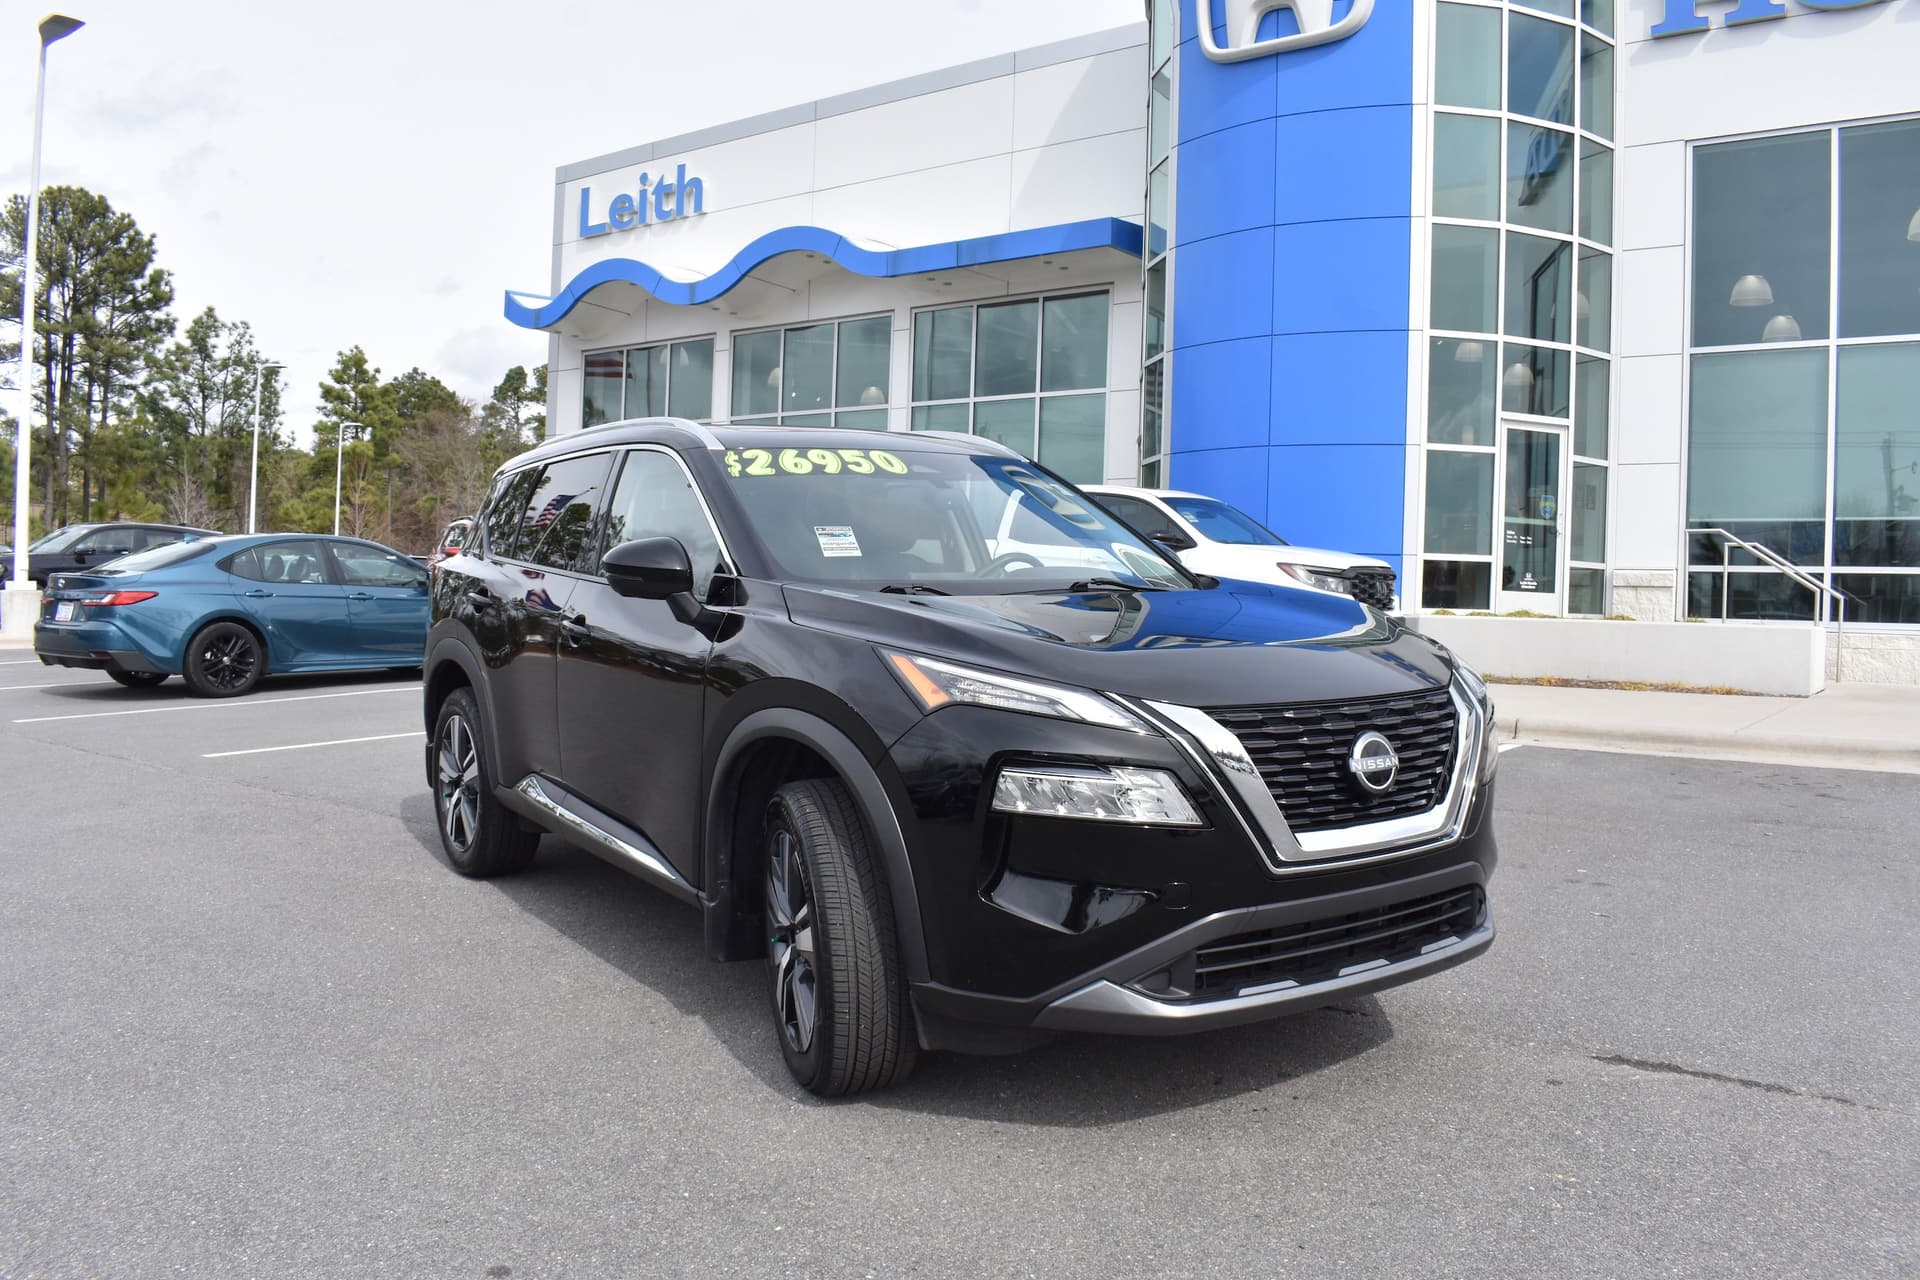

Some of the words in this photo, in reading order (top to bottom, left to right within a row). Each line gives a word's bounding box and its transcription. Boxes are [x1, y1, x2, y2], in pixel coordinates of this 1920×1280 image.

[580, 164, 704, 238] Leith
[724, 449, 909, 478] $26950
[1351, 755, 1399, 771] NISSAN
